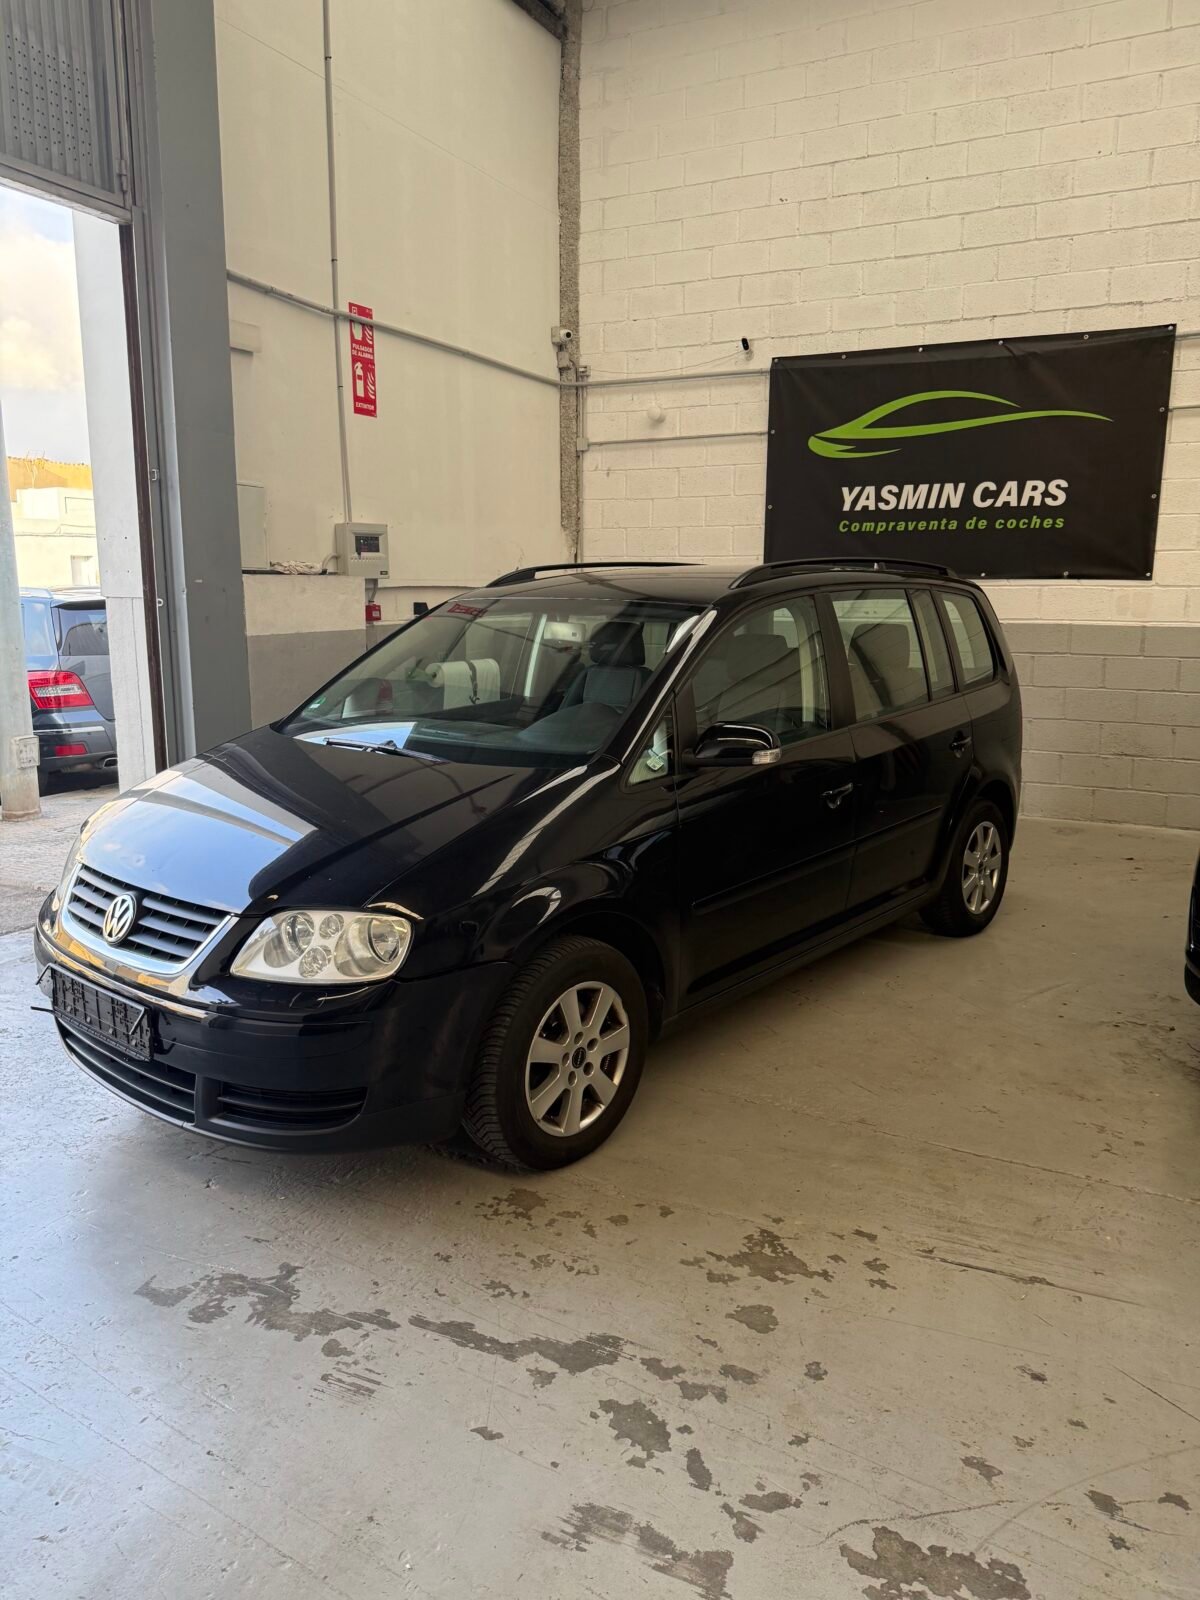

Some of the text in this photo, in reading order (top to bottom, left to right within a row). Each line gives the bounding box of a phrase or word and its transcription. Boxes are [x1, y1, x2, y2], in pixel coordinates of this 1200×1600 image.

[352, 344, 373, 353] PULSADOR
[355, 402, 375, 410] EXTINTOR
[841, 479, 1069, 511] YASMIN CARS
[839, 515, 1065, 534] Compraventa de coches
[103, 894, 136, 942] VW
